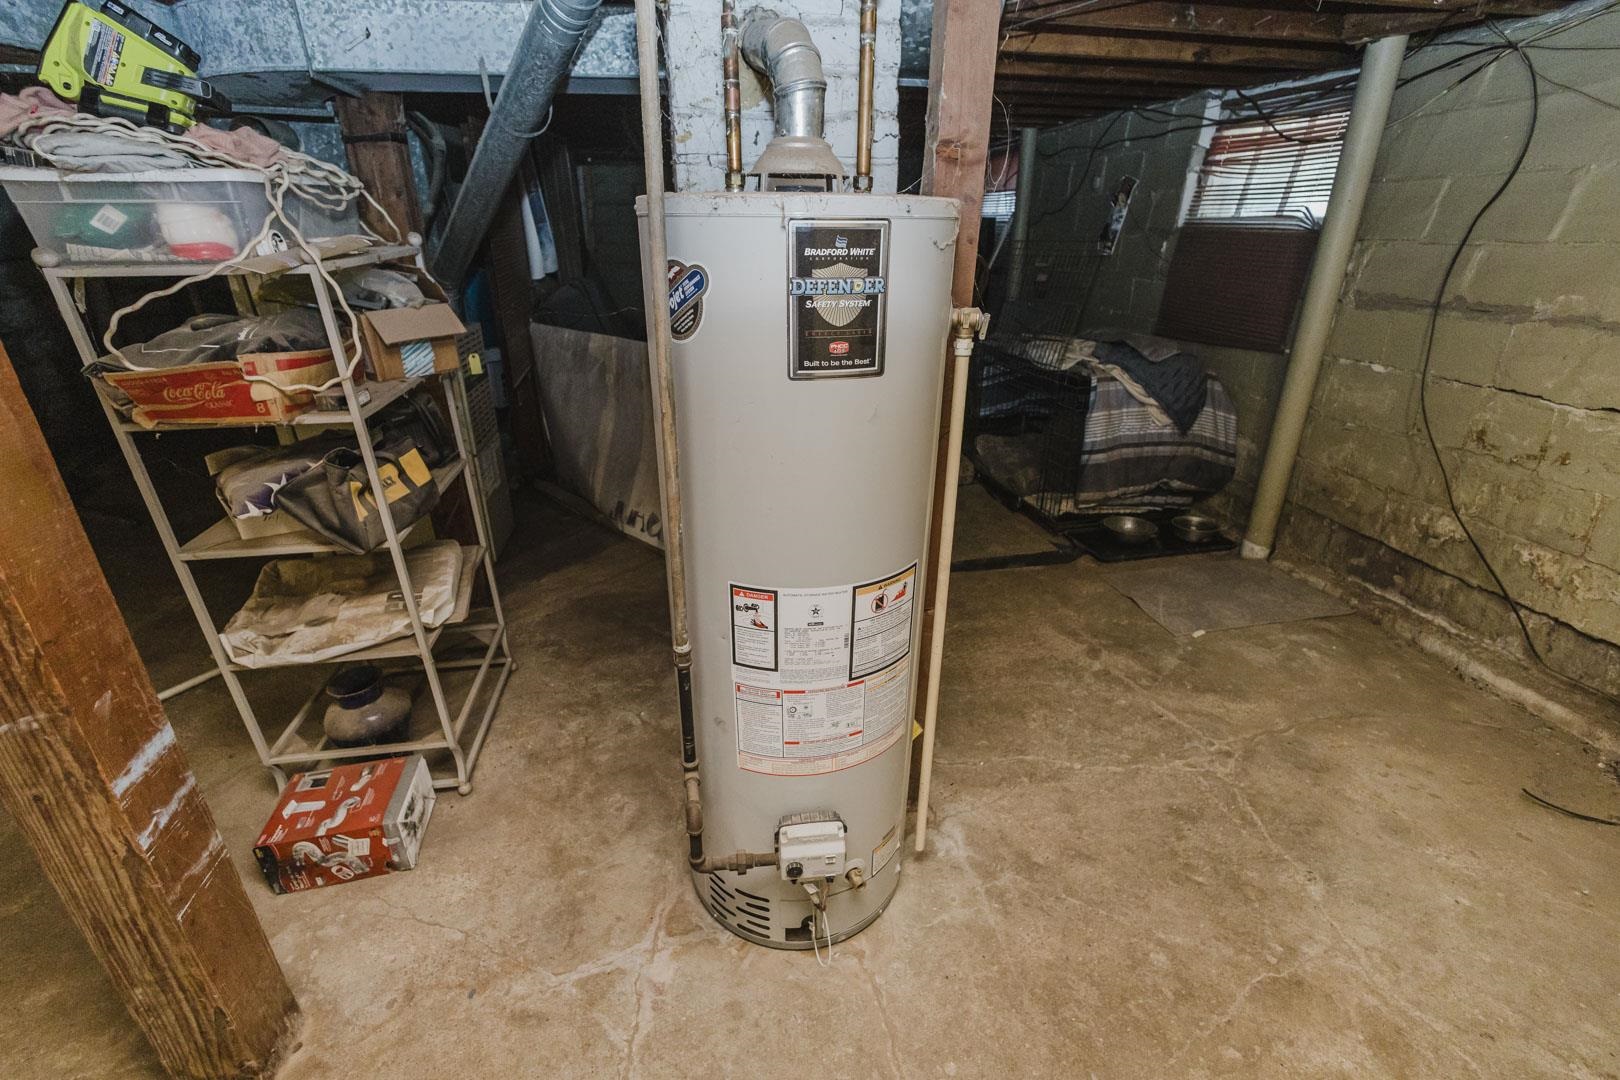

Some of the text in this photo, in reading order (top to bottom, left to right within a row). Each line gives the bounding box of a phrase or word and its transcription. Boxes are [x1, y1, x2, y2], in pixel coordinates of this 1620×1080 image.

[804, 247, 874, 256] BRADFORD WHITE
[790, 276, 885, 296] DEFENDER
[805, 300, 871, 309] SAFETY SYSTEM
[854, 358, 870, 366] Best
[256, 402, 266, 414] 8
[746, 592, 769, 600] DANGER
